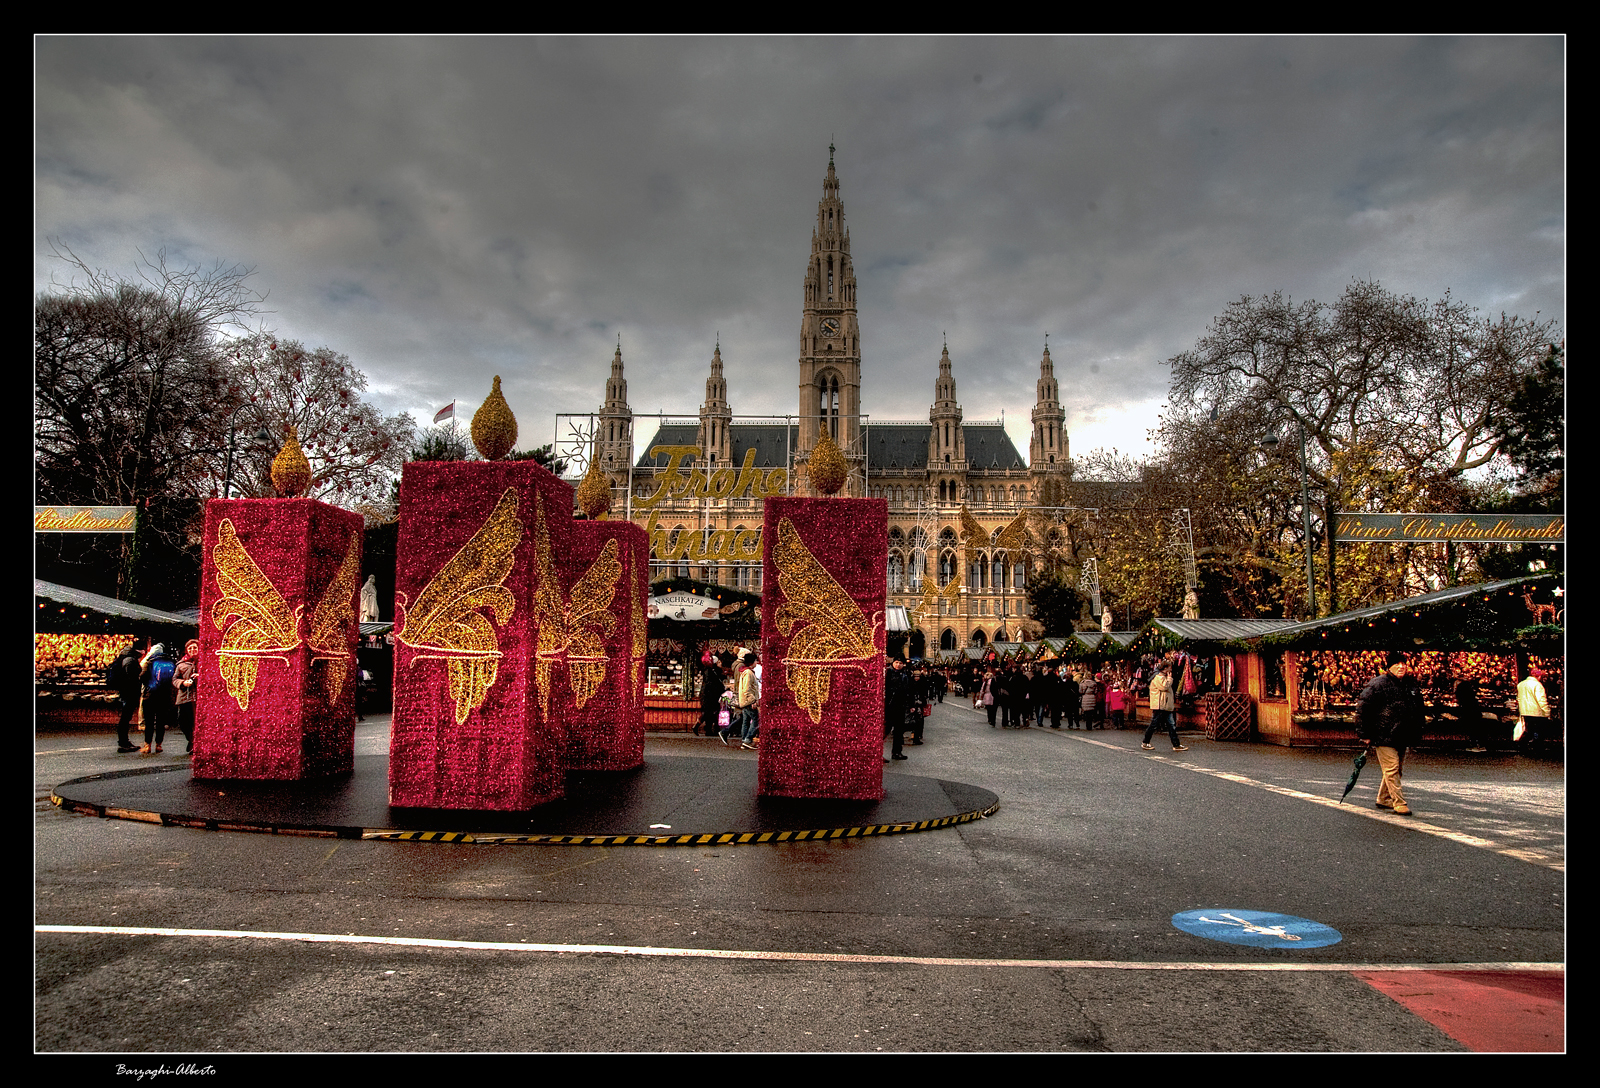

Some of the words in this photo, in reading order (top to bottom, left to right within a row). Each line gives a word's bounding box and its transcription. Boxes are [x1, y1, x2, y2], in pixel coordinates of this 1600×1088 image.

[632, 445, 787, 507] Frohe
[1336, 517, 1397, 537] Wiener
[1401, 517, 1564, 538] Christkindlmarkt
[655, 596, 705, 606] NASCHKATZE
